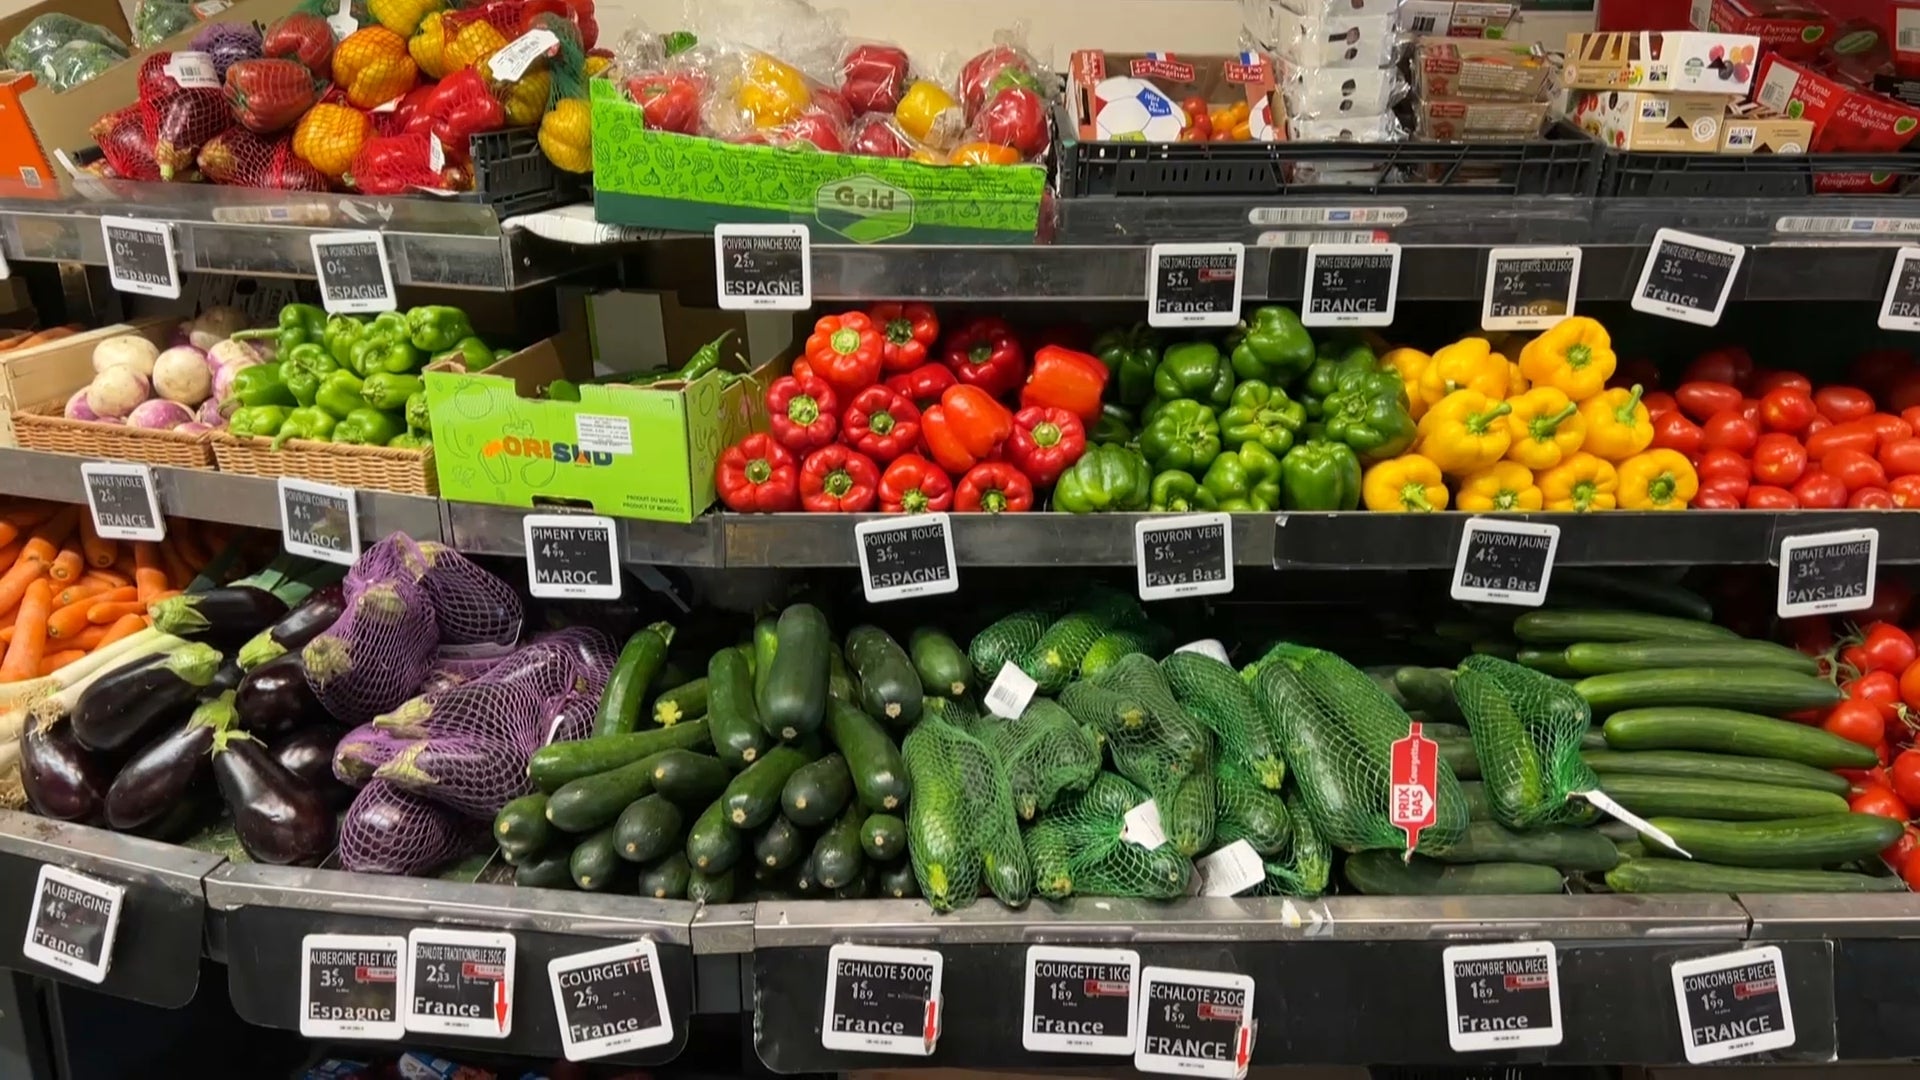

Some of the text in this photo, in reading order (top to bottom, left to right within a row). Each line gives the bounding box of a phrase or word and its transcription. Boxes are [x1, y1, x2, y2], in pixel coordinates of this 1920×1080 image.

[835, 186, 894, 211] Gold
[722, 237, 753, 250] POIVRON
[754, 237, 783, 250] PANACHE
[115, 265, 168, 285] Espagne
[328, 284, 385, 300] ESPAGNE
[725, 280, 801, 295] ESPAGNE
[1643, 283, 1698, 307] France
[1157, 299, 1214, 313] France
[1311, 298, 1377, 313] FRANCE
[1491, 302, 1548, 316] France
[502, 436, 614, 467] ORISUD
[88, 475, 146, 489] NAVET VIOLET
[99, 512, 147, 527] FRANCE
[290, 527, 340, 549] MAROC
[532, 529, 608, 542] PIMENT VERT
[865, 526, 944, 546] POIVRON ROUGE
[1144, 526, 1223, 545] POIVRON VERT
[1471, 532, 1550, 551] POIVRON JAUNE
[1790, 542, 1869, 562] TOMATE ALLONGEE
[536, 569, 598, 585] MAROC
[871, 566, 947, 589] ESPAGNE
[1147, 568, 1222, 587] Pays Bas
[1463, 572, 1537, 592] Pays Bas
[1787, 582, 1863, 603] PAYS-BAS
[1398, 787, 1410, 819] PRIX
[1411, 790, 1423, 817] BAS
[43, 880, 112, 915] AUBERGINE
[33, 926, 85, 958] France
[310, 950, 357, 966] AUBERGINE
[359, 951, 380, 966] FILET
[416, 944, 443, 961] ECHALOTE
[559, 957, 651, 989] COURGETTE
[838, 961, 932, 982] ECHALOTE 500G
[1035, 962, 1130, 981] COURGETTE 1KG
[1454, 958, 1548, 977] CONCOMBRE NOA PIECE
[1683, 971, 1747, 993] CONCOMBRE
[1747, 963, 1776, 981] PIECE
[1150, 982, 1209, 1001] ECHALOTE
[1213, 991, 1244, 1007] 250G
[310, 1002, 391, 1021] Espagne
[414, 997, 481, 1018] France
[570, 1017, 639, 1043] France
[833, 1013, 904, 1034] France
[1033, 1015, 1104, 1035] France
[1458, 1014, 1528, 1033] France
[1692, 1015, 1771, 1045] FRANCE
[1147, 1035, 1227, 1060] FRANCE
